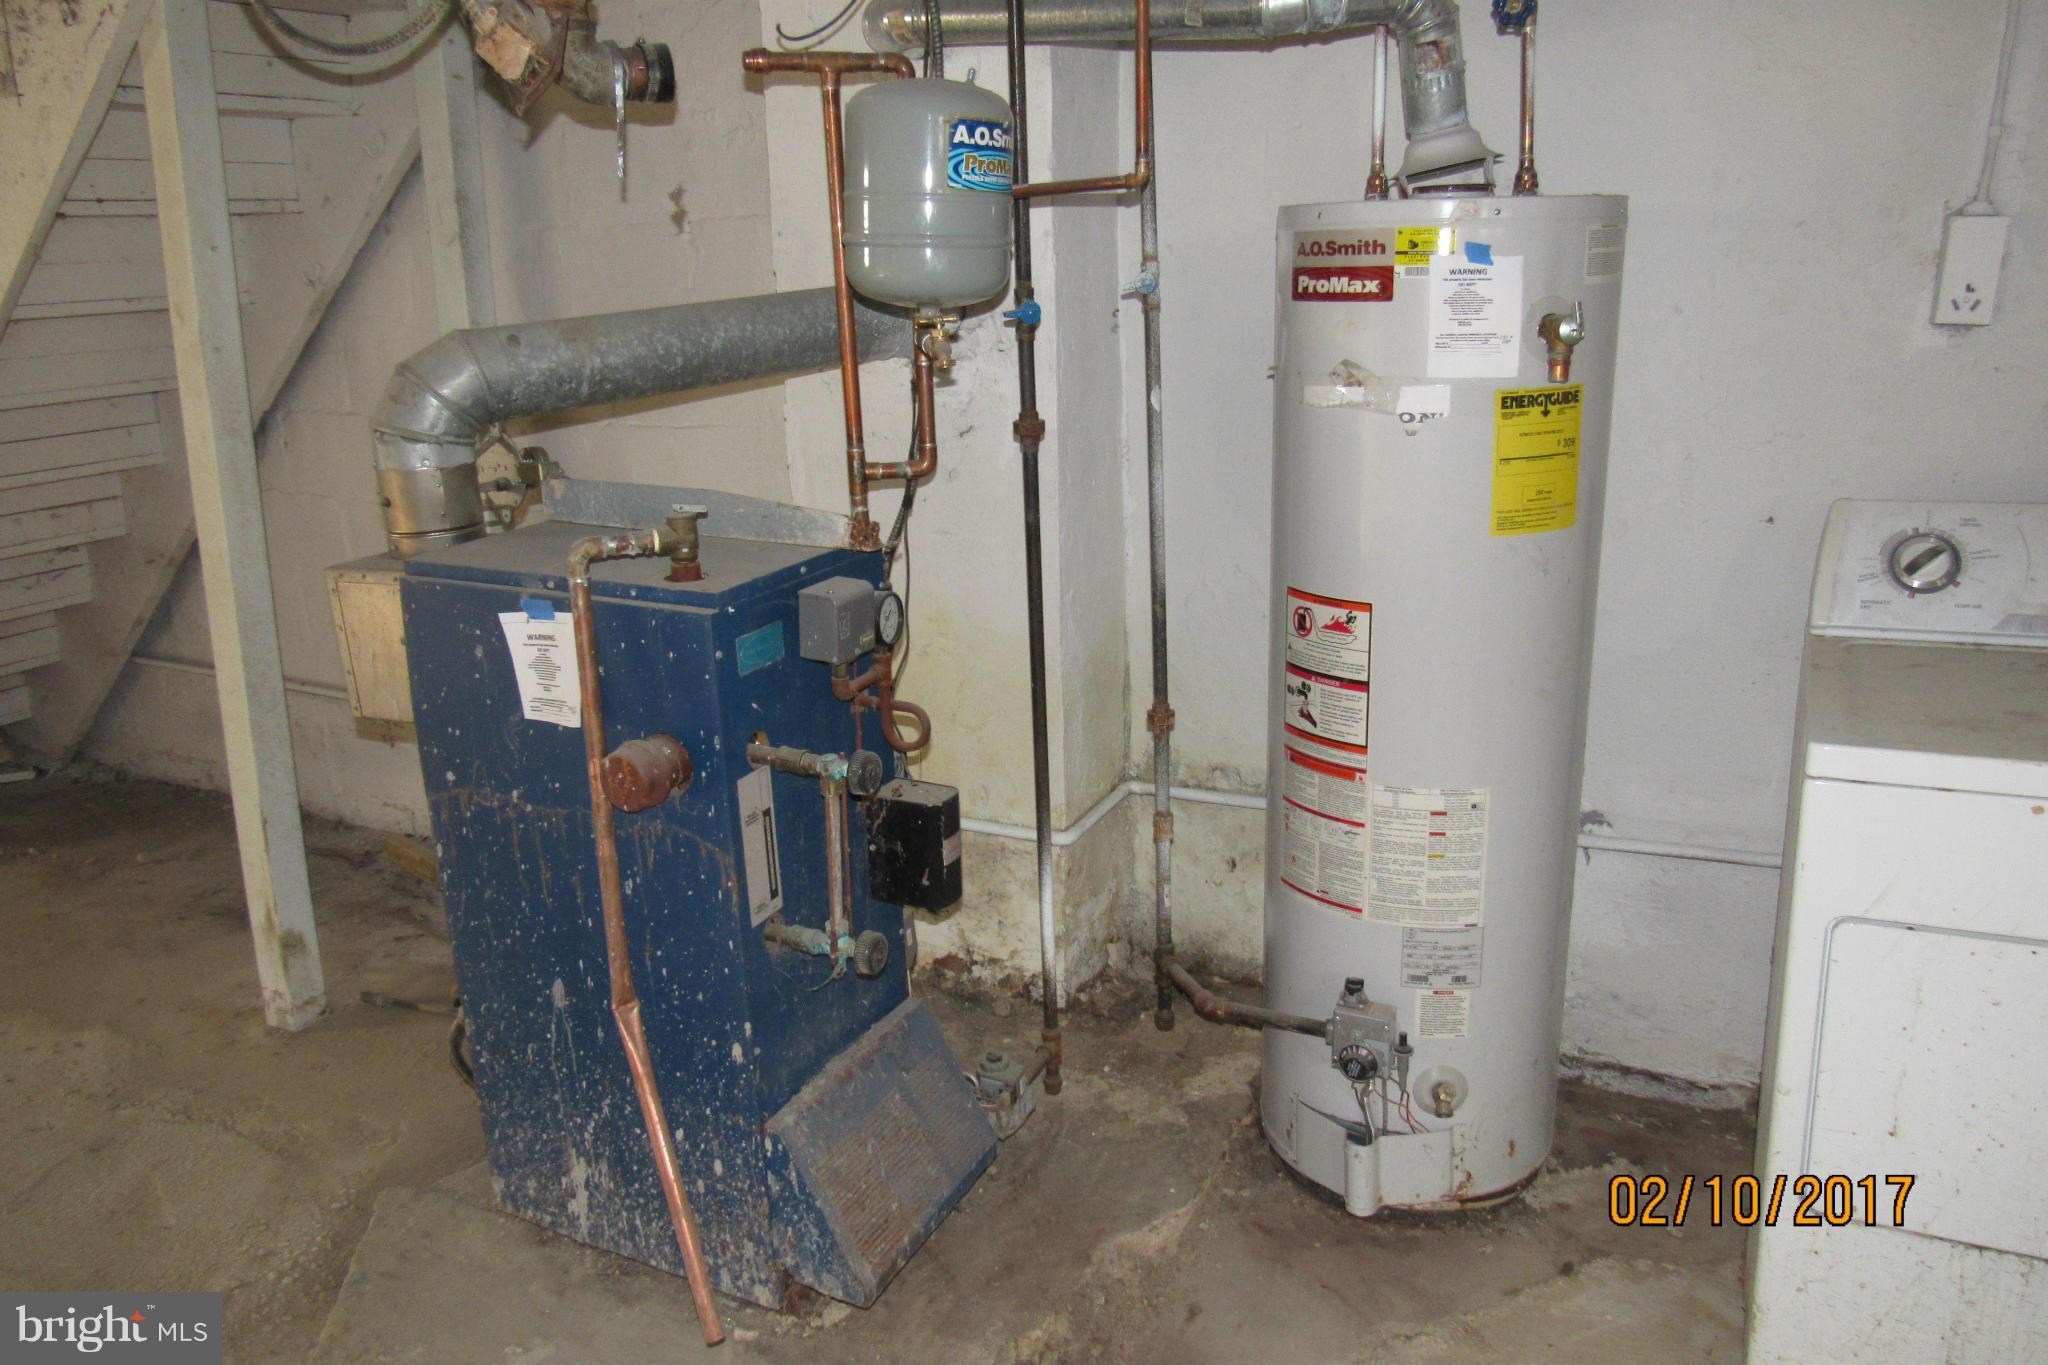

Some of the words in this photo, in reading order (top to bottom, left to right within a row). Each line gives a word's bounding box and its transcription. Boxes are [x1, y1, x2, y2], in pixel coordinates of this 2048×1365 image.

[963, 153, 1010, 175] ProM
[1297, 240, 1386, 257] A.O.Smith
[1449, 268, 1488, 276] WARNING
[1298, 275, 1380, 294] ProMax
[526, 633, 556, 641] WARNING
